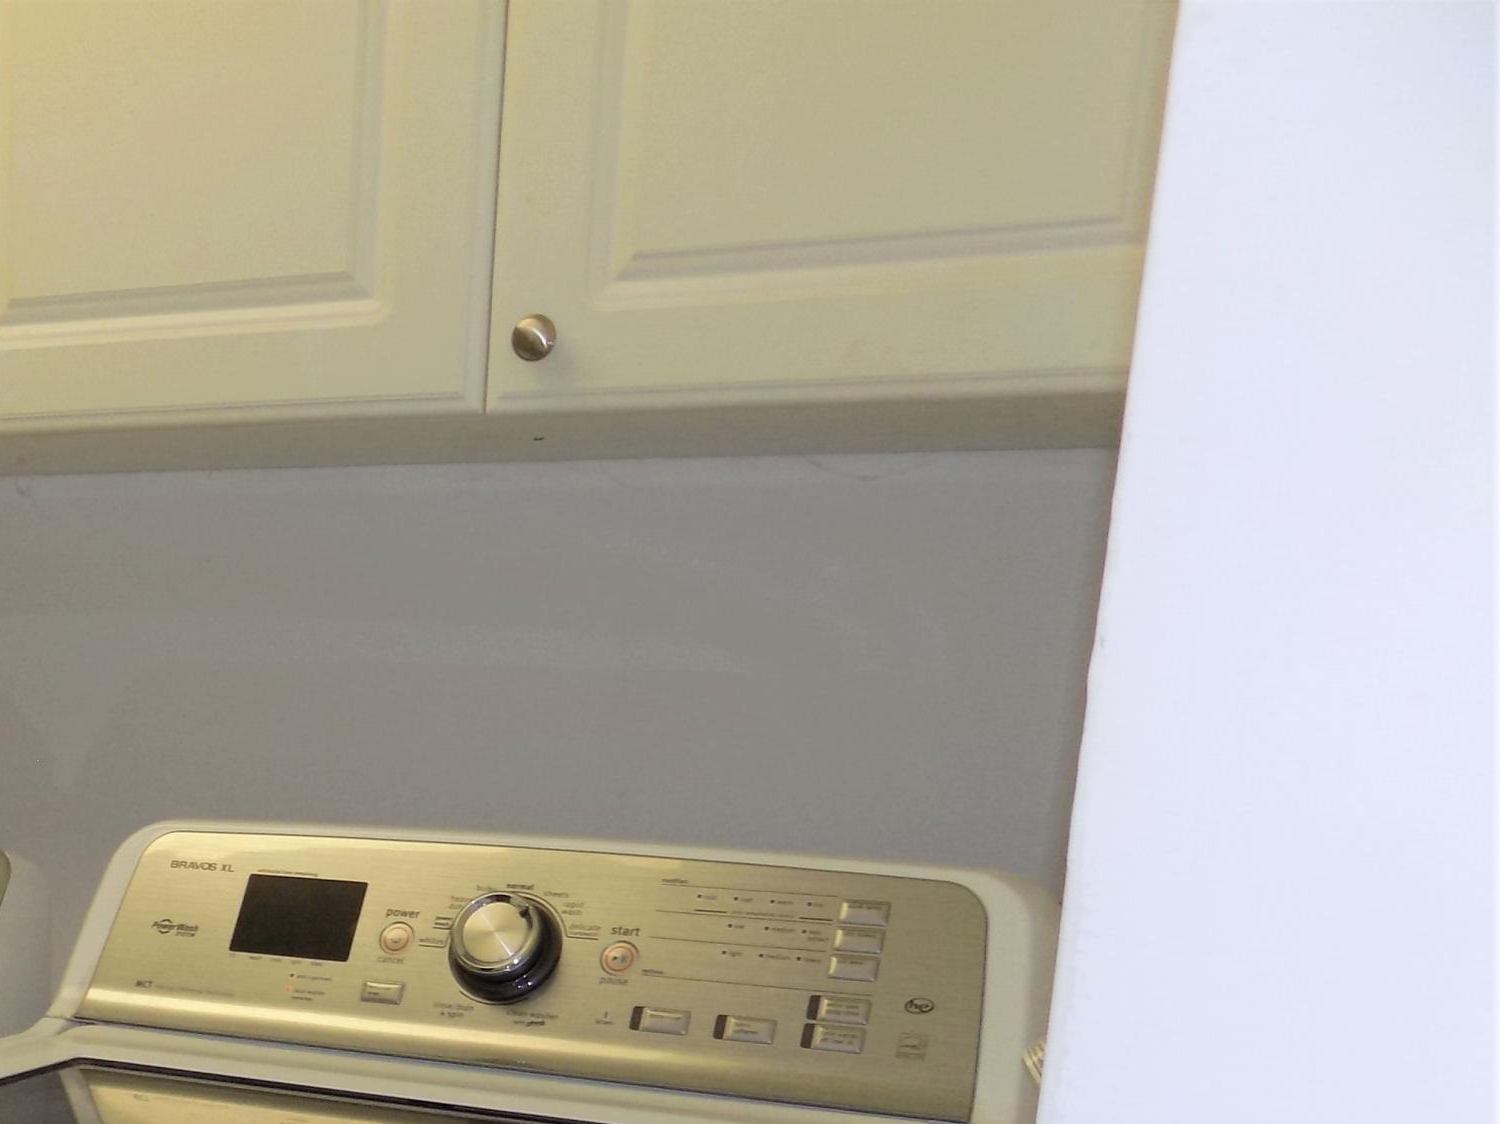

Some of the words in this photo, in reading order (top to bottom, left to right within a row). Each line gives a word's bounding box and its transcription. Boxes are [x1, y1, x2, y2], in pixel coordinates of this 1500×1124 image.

[170, 859, 218, 873] BRAVOS
[219, 862, 236, 873] XL
[385, 908, 421, 920] power
[610, 925, 642, 937] start
